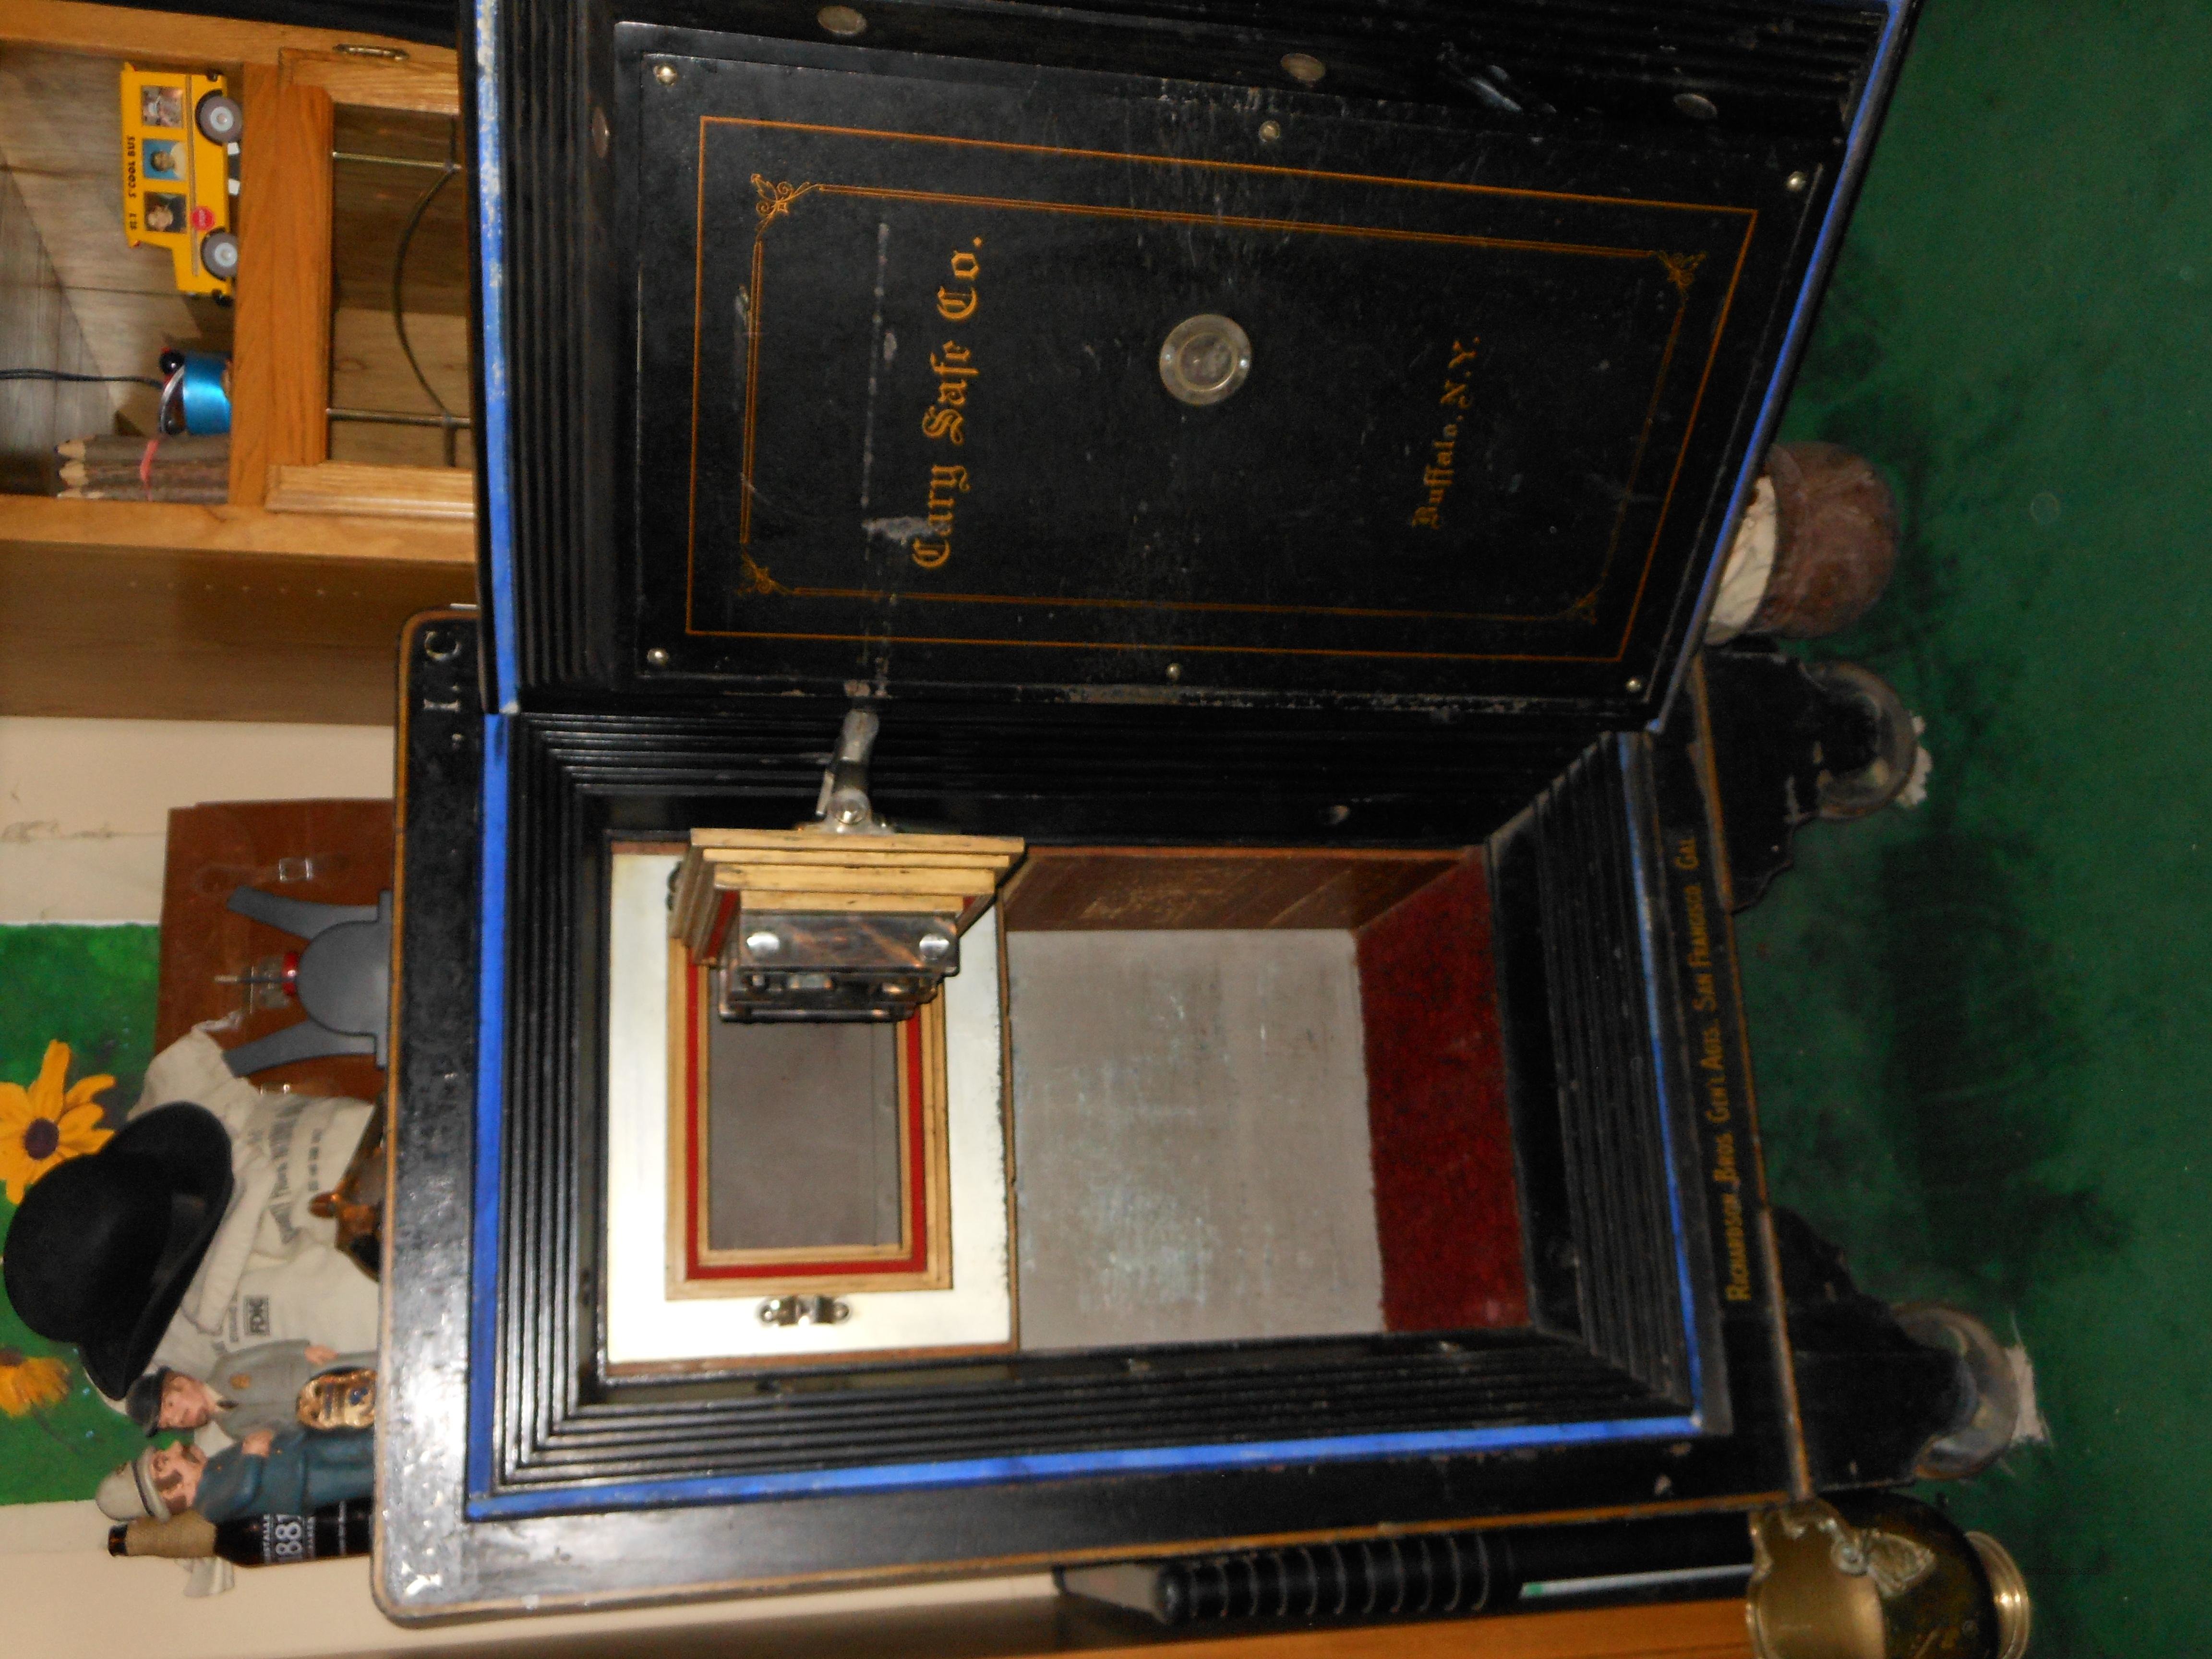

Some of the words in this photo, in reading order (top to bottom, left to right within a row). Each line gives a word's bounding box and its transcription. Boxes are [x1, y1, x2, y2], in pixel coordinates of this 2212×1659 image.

[126, 135, 135, 157] BUS
[937, 236, 983, 322] Co.
[922, 340, 980, 445] Safe
[912, 465, 971, 569] Cary
